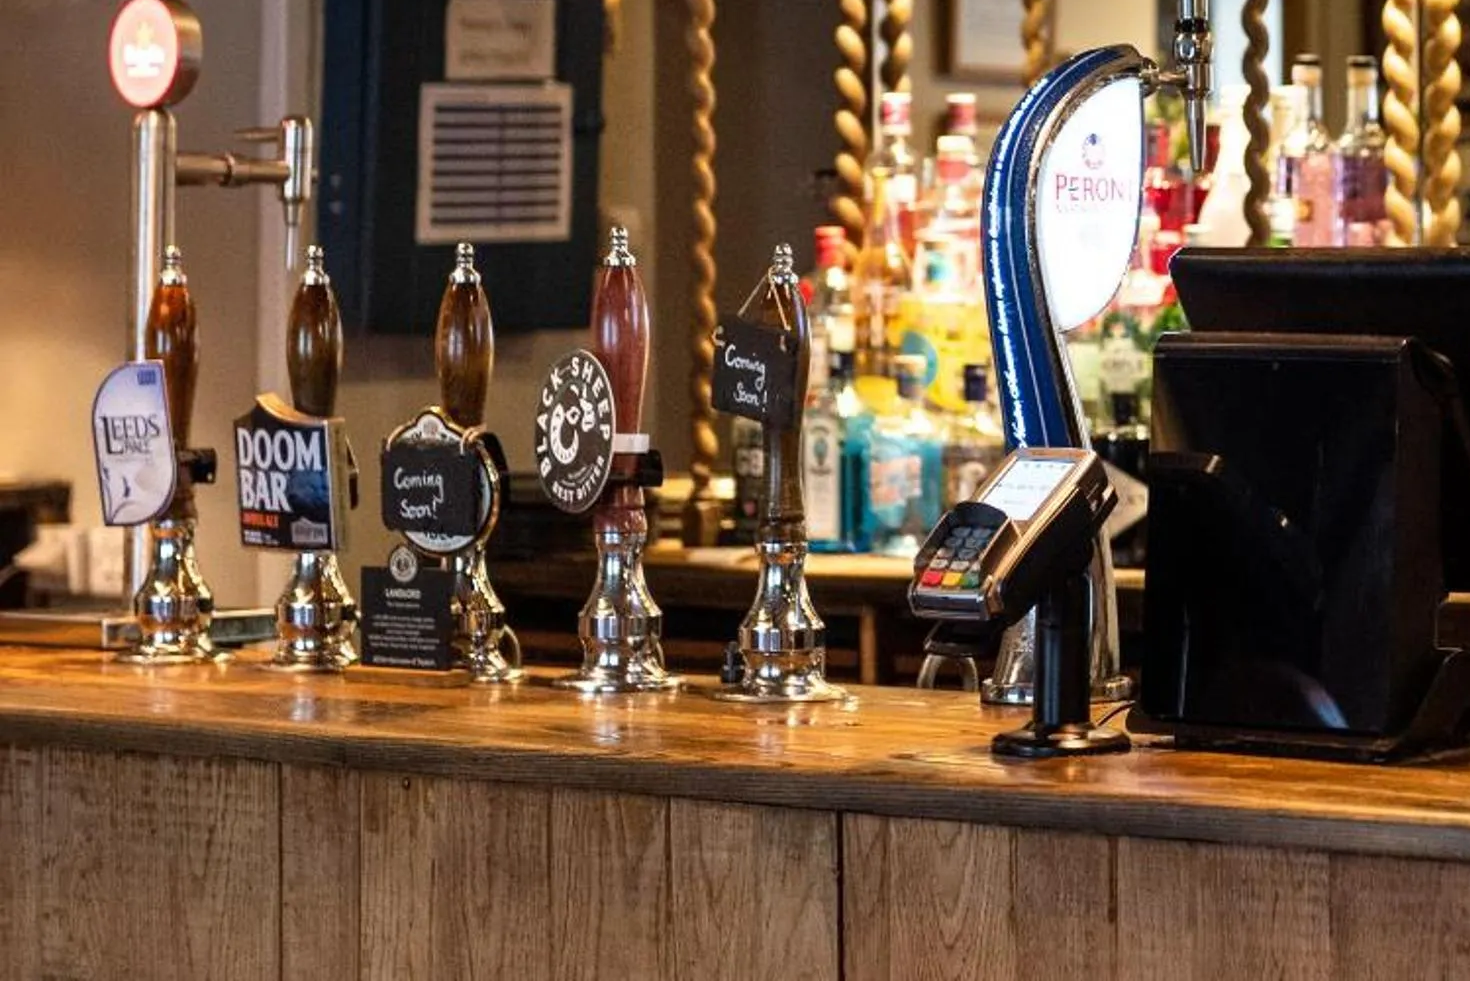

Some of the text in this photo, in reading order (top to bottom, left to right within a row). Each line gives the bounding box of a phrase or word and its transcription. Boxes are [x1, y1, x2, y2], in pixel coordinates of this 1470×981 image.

[725, 343, 766, 392] Coming
[536, 356, 611, 479] BLACK SHEEP
[733, 381, 768, 414] Soon!
[99, 413, 161, 455] LEEDS
[236, 427, 323, 472] DOOM
[241, 468, 293, 512] BAR
[393, 466, 444, 504] Coming
[551, 455, 606, 505] BEST BITTER
[400, 495, 439, 519] Soon!
